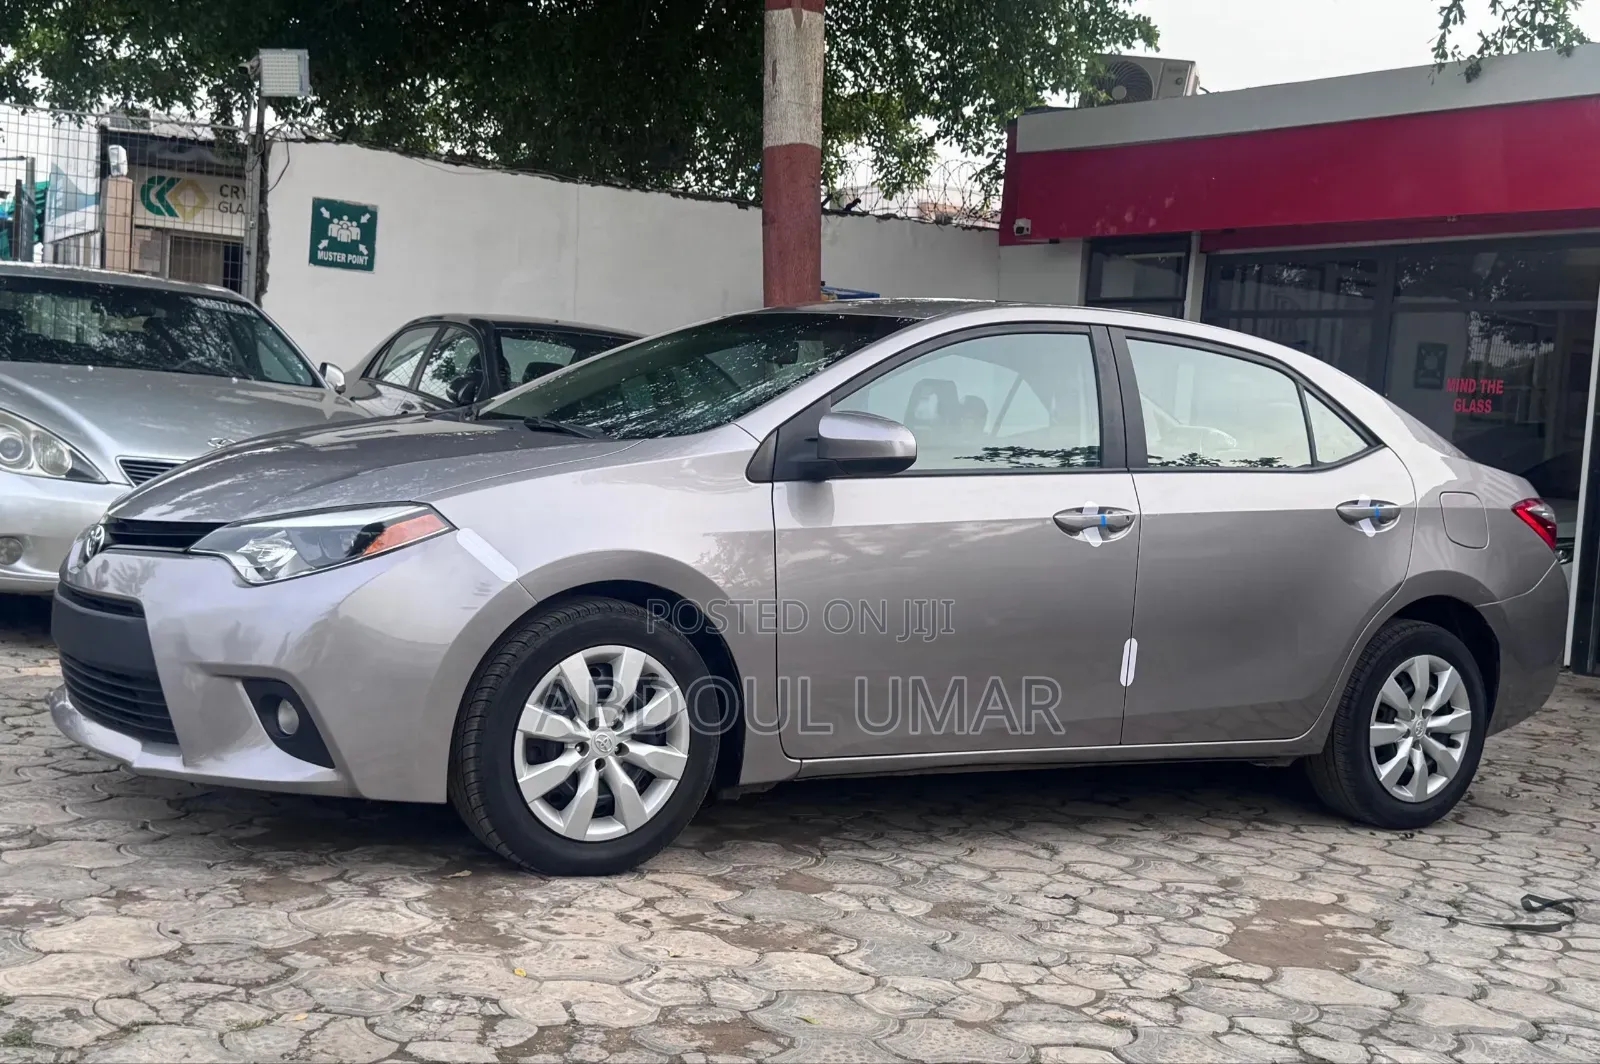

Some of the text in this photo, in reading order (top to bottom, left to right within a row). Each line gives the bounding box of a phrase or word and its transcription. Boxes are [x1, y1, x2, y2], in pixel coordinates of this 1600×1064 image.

[218, 201, 245, 216] GLA
[317, 250, 369, 266] MUSTER POINT
[1446, 378, 1477, 393] MIND
[1480, 379, 1504, 394] THE
[1453, 398, 1492, 414] GLASS
